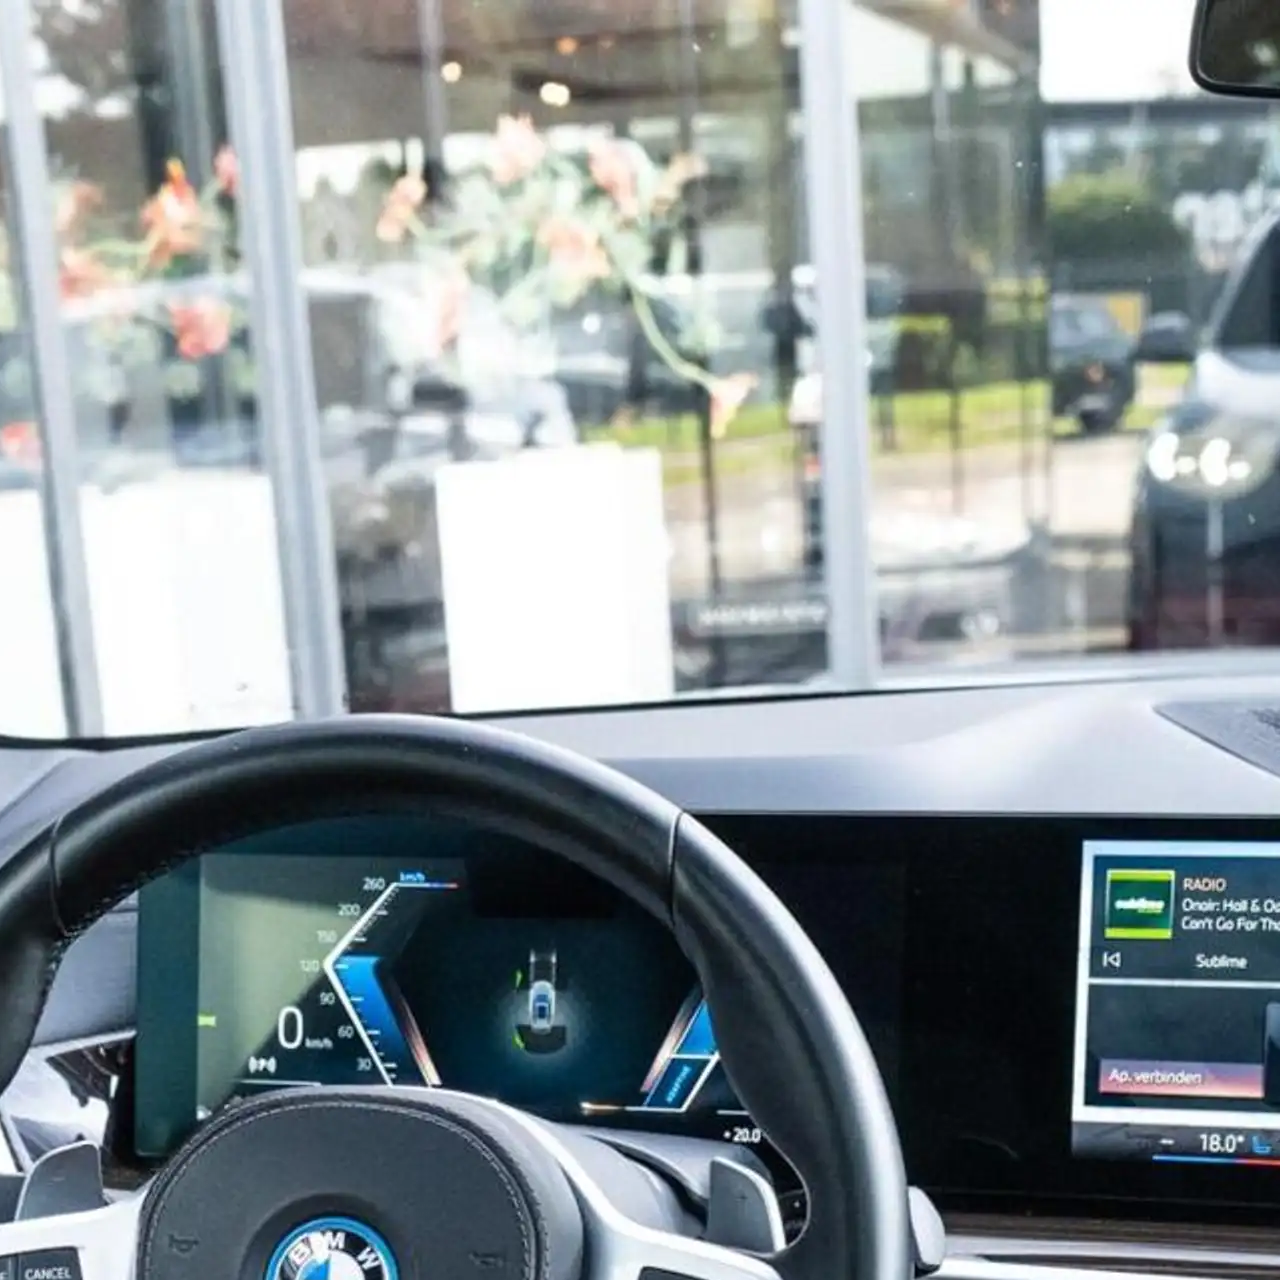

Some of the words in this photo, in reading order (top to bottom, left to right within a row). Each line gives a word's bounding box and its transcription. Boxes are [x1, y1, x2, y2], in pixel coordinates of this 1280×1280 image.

[363, 876, 385, 891] 260
[1182, 878, 1227, 891] RADIO
[338, 903, 361, 917] 200
[1224, 898, 1248, 913] Hall
[1251, 899, 1261, 913] &
[1215, 917, 1234, 932] Go
[1237, 918, 1258, 931] For
[1195, 953, 1248, 969] Sublime
[319, 992, 335, 1005] 90
[277, 1005, 304, 1050] 0
[337, 1025, 354, 1039] 60
[1134, 1071, 1202, 1085] verbinden
[1199, 1133, 1245, 1153] 18.0°
[288, 1229, 381, 1271] BMW
